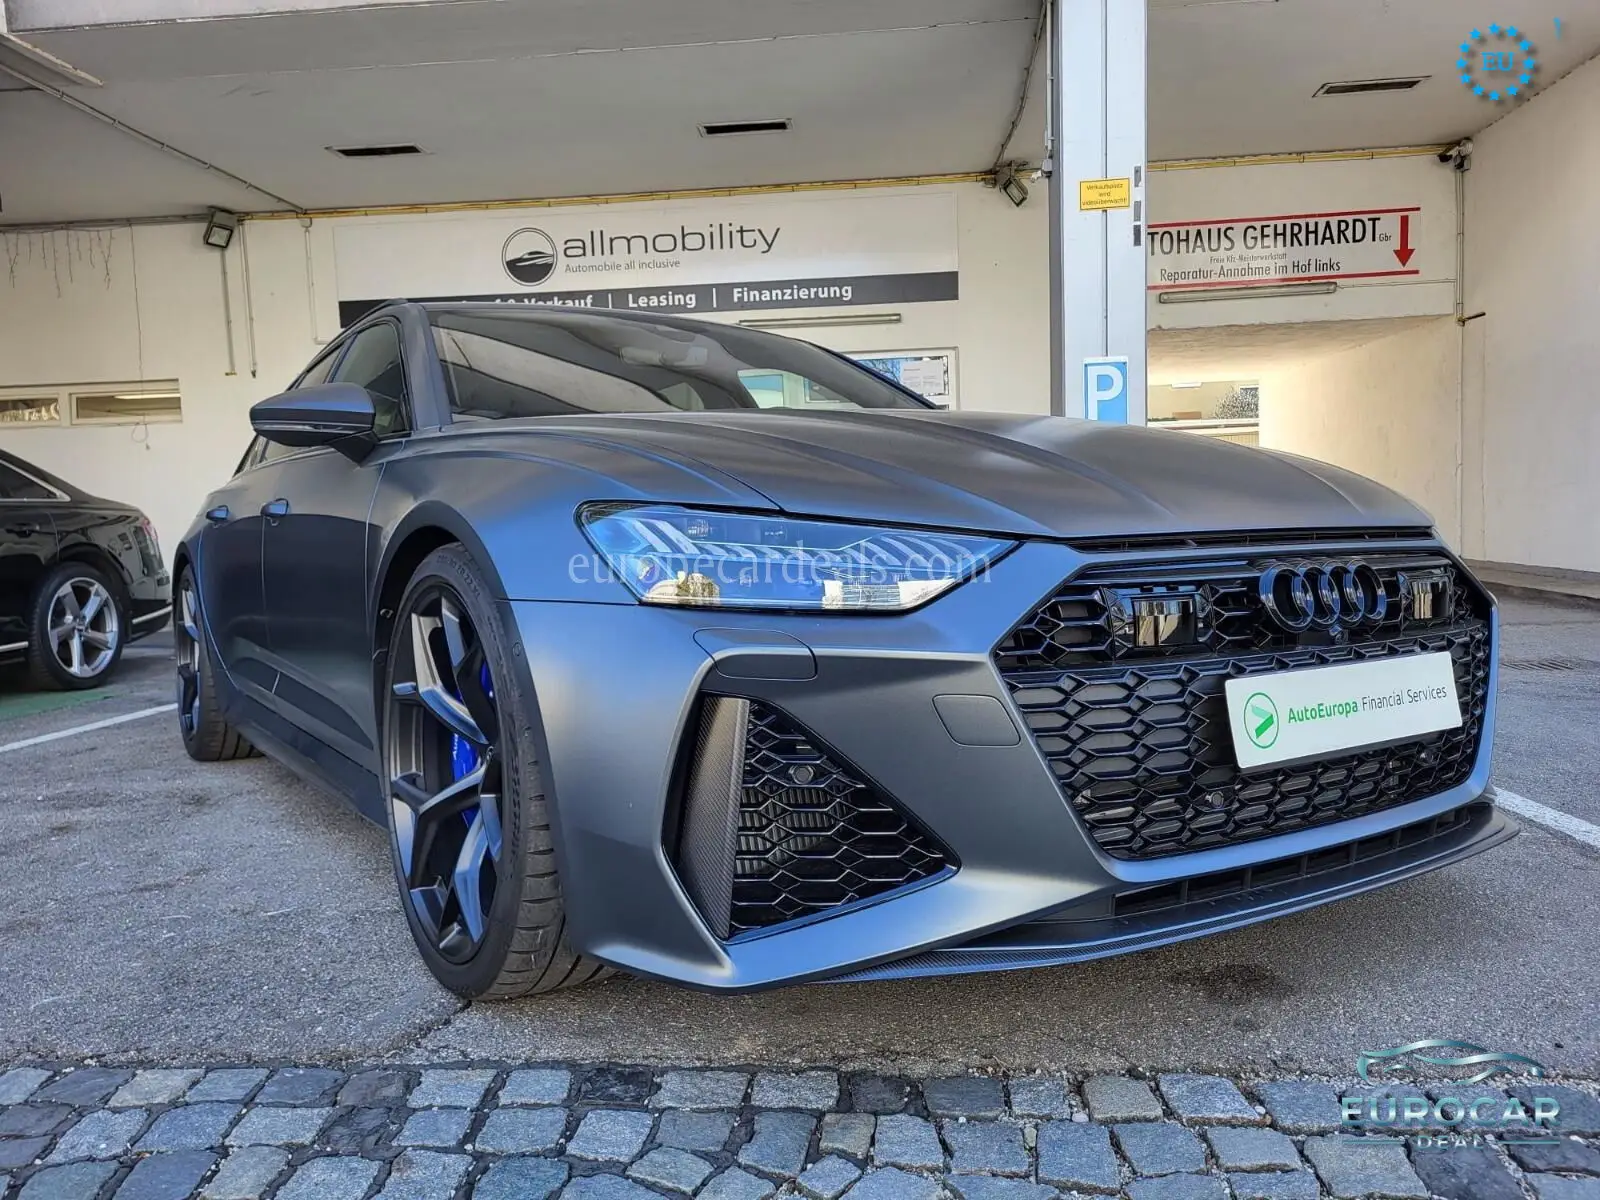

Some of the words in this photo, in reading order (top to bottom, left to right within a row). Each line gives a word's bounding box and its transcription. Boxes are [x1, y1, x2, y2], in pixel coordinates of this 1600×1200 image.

[563, 222, 781, 258] allmobility
[1243, 217, 1381, 250] GEHRHARDT
[1378, 232, 1392, 242] Gbr
[565, 260, 622, 273] Automobile
[624, 260, 636, 271] all
[639, 259, 681, 270] inclusive
[1160, 263, 1271, 284] Reparatur-Annahme
[1274, 262, 1288, 275] im
[1292, 258, 1312, 274] Hof
[1315, 258, 1341, 273] links
[628, 290, 696, 308] Leasing
[733, 285, 852, 303] Finanzierung
[1088, 365, 1123, 420] P
[1288, 700, 1358, 724] AutoEuropa
[1362, 688, 1405, 712] Financial
[1407, 685, 1447, 704] Services
